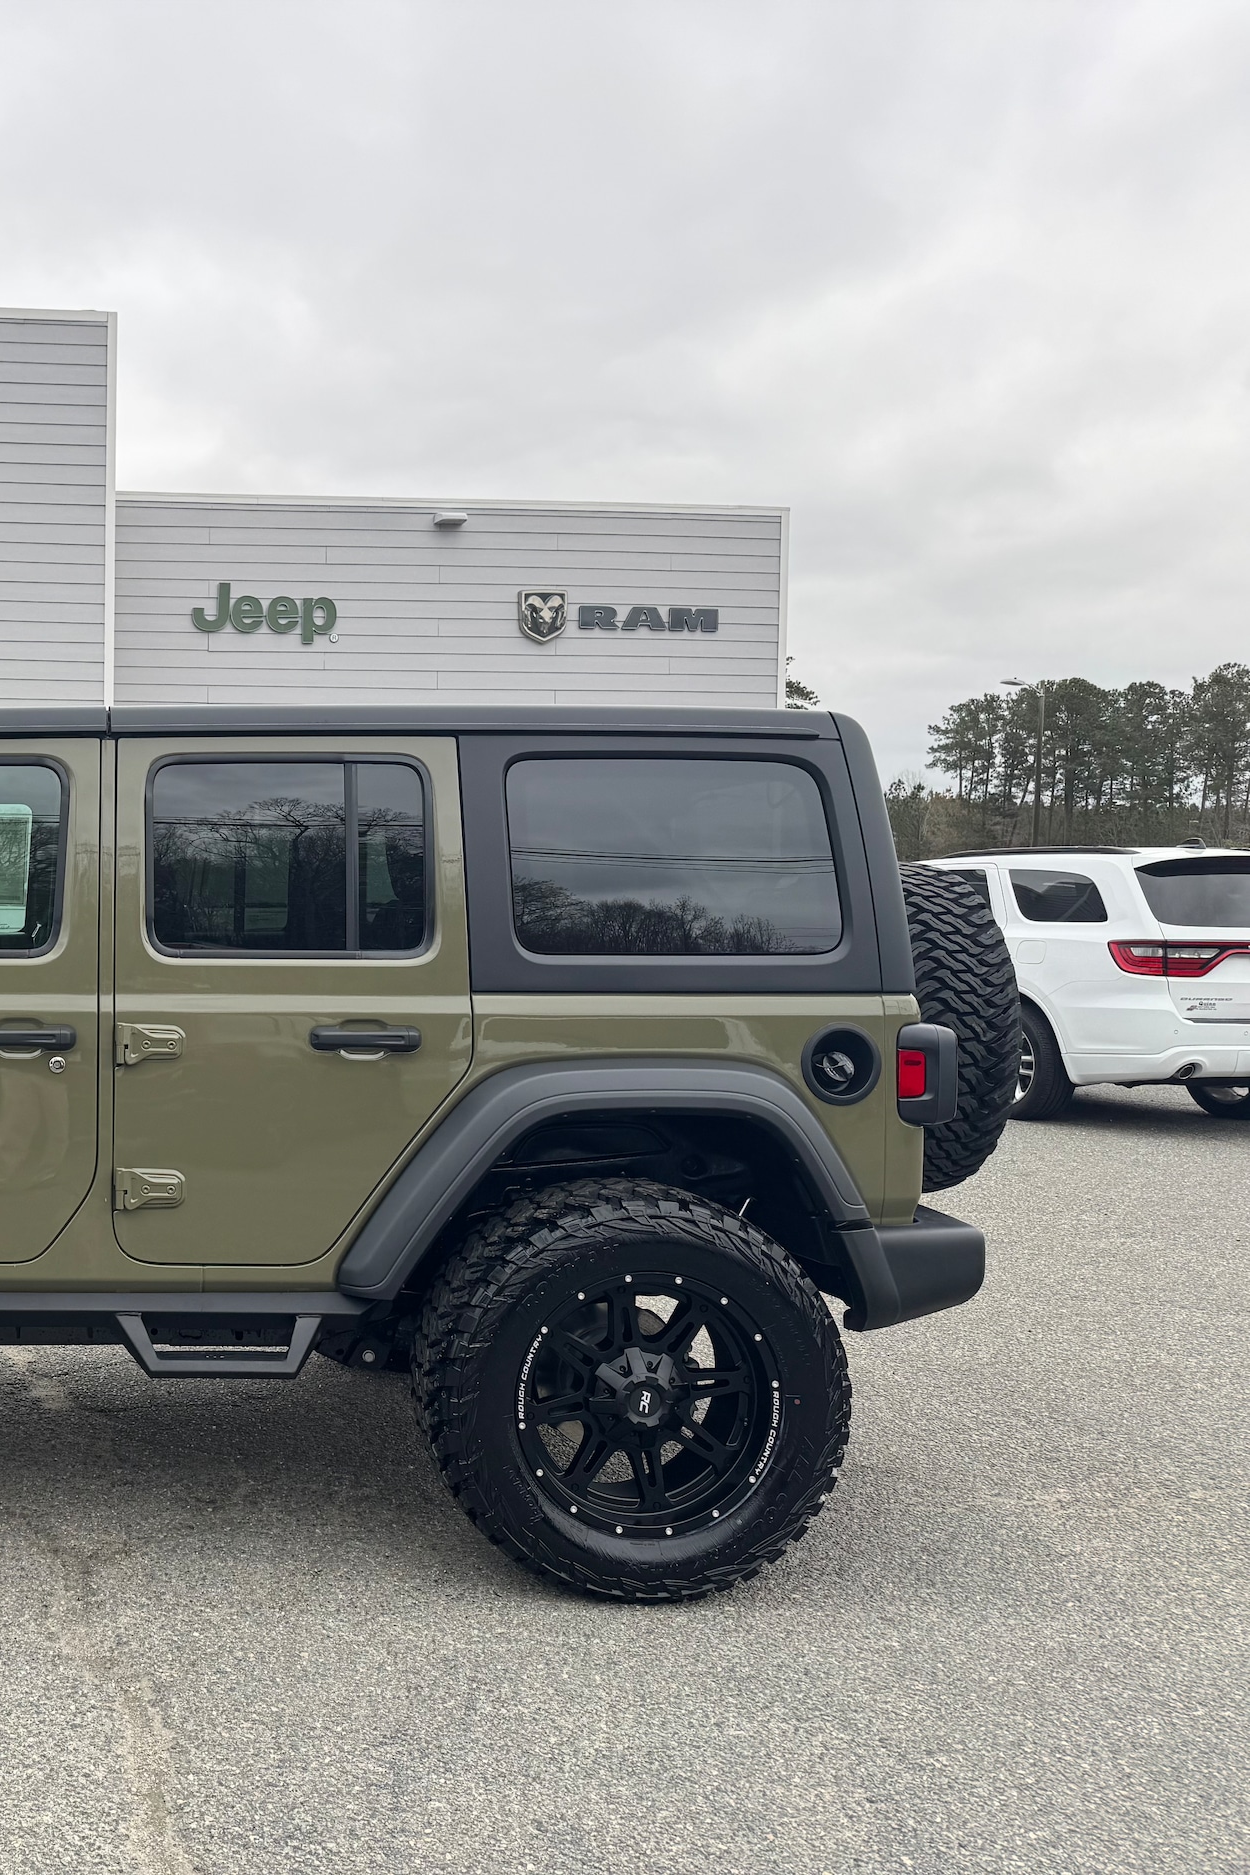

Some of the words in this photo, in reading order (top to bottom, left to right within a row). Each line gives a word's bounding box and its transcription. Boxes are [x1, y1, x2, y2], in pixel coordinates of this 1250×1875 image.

[192, 582, 337, 644] Jeep
[579, 605, 719, 632] RAM
[521, 1334, 543, 1381] COUNTRY
[517, 1382, 526, 1419] ROUGH
[639, 1390, 651, 1414] RC
[771, 1391, 780, 1428] ROUGH
[755, 1428, 777, 1476] COUNTRY
